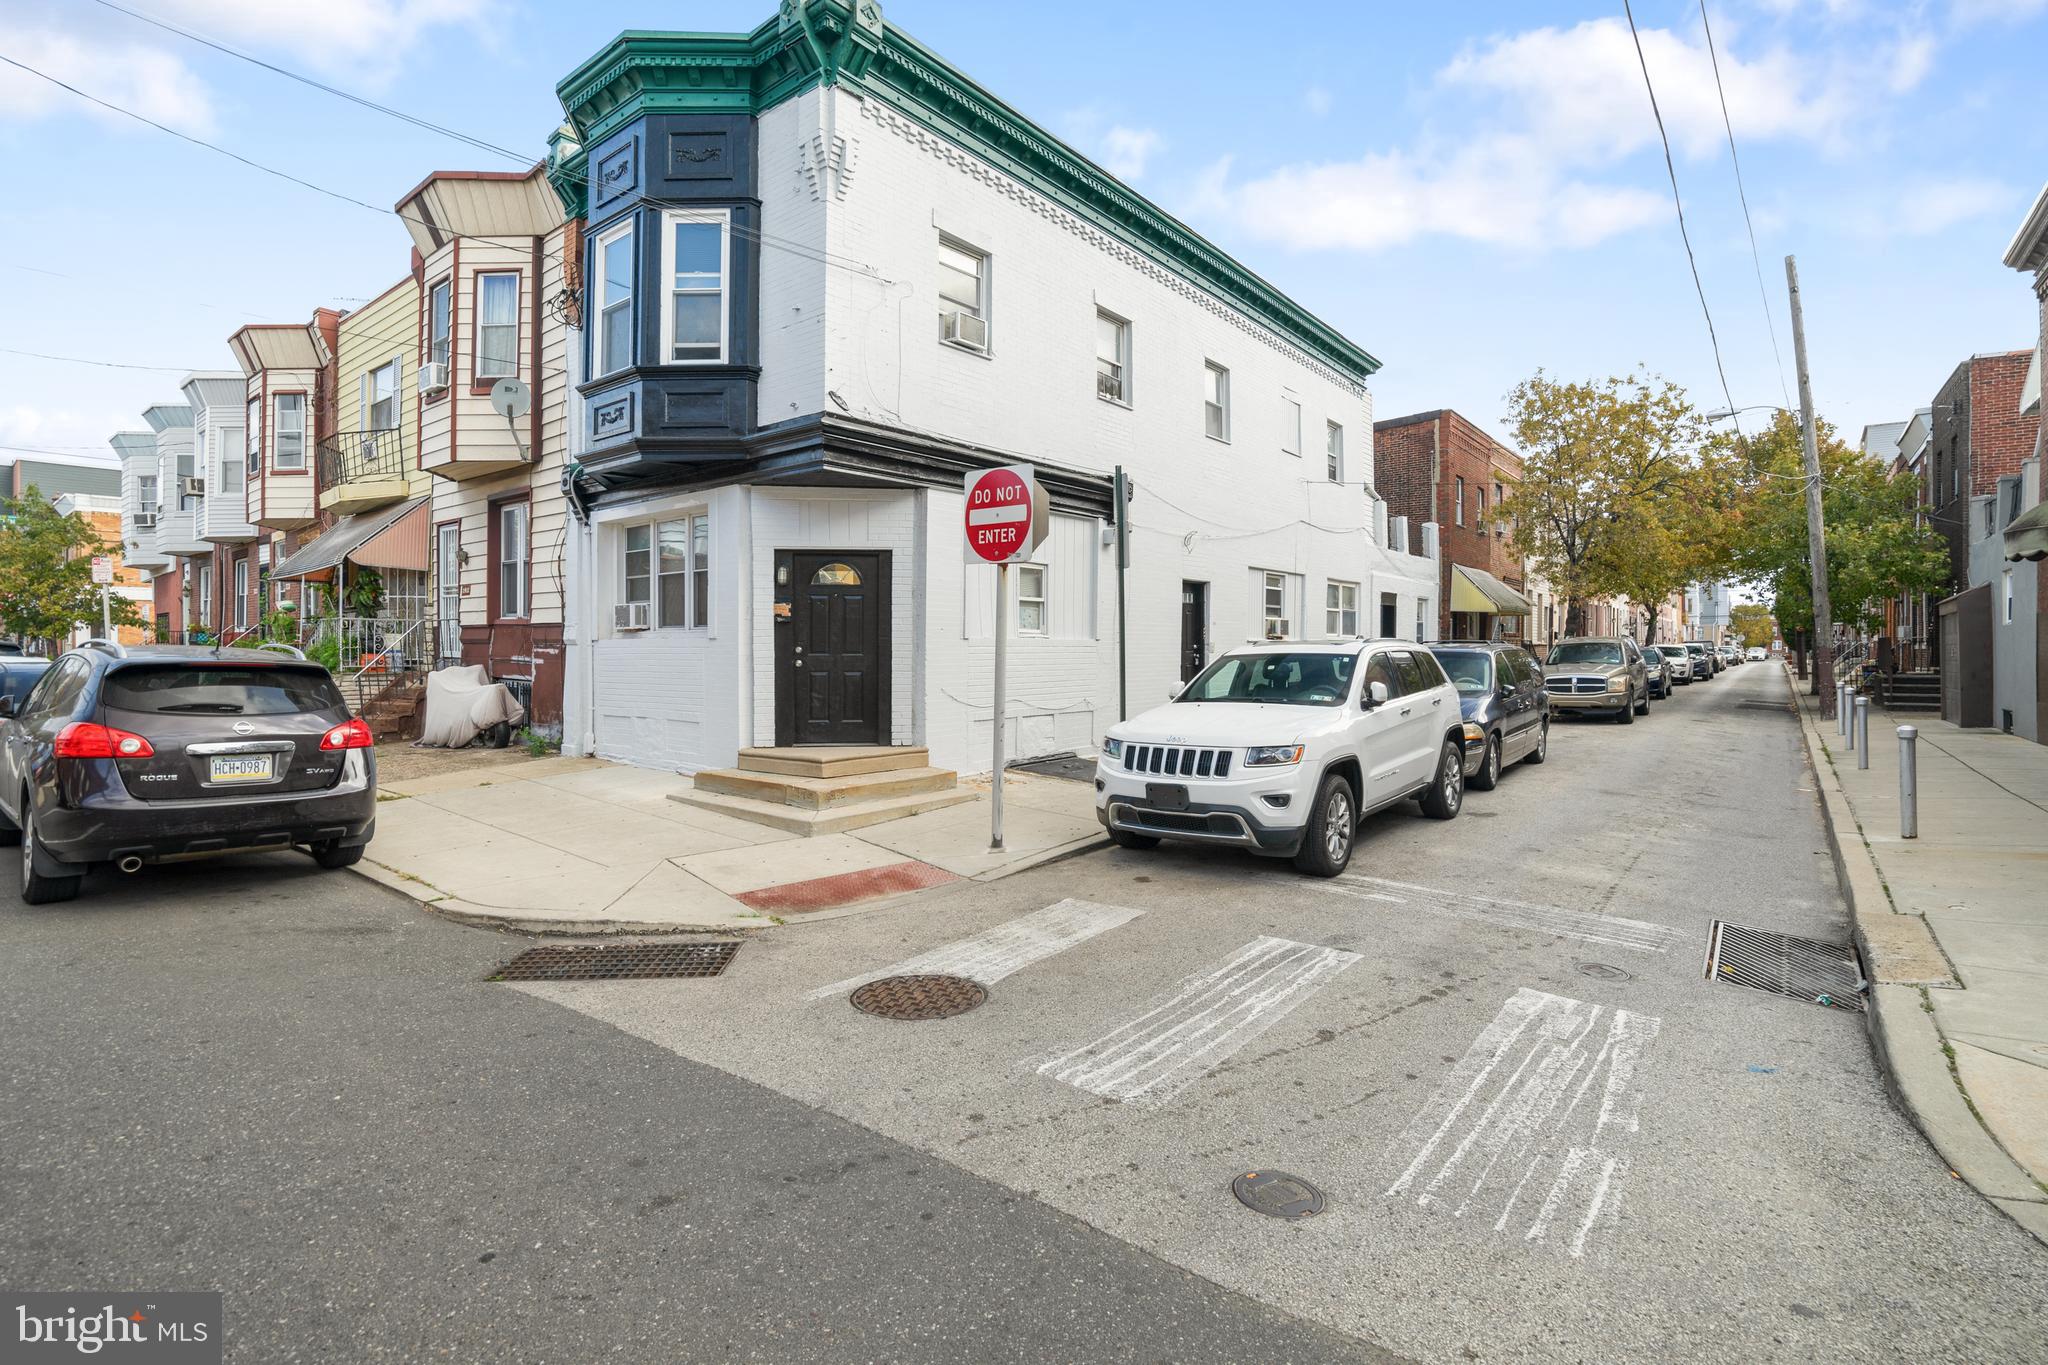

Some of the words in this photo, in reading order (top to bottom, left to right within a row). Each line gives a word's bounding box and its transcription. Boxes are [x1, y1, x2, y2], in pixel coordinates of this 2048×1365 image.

[975, 489, 991, 504] DO
[996, 485, 1022, 501] NOT
[978, 528, 1016, 544] ENTER
[140, 774, 178, 782] ROGUE
